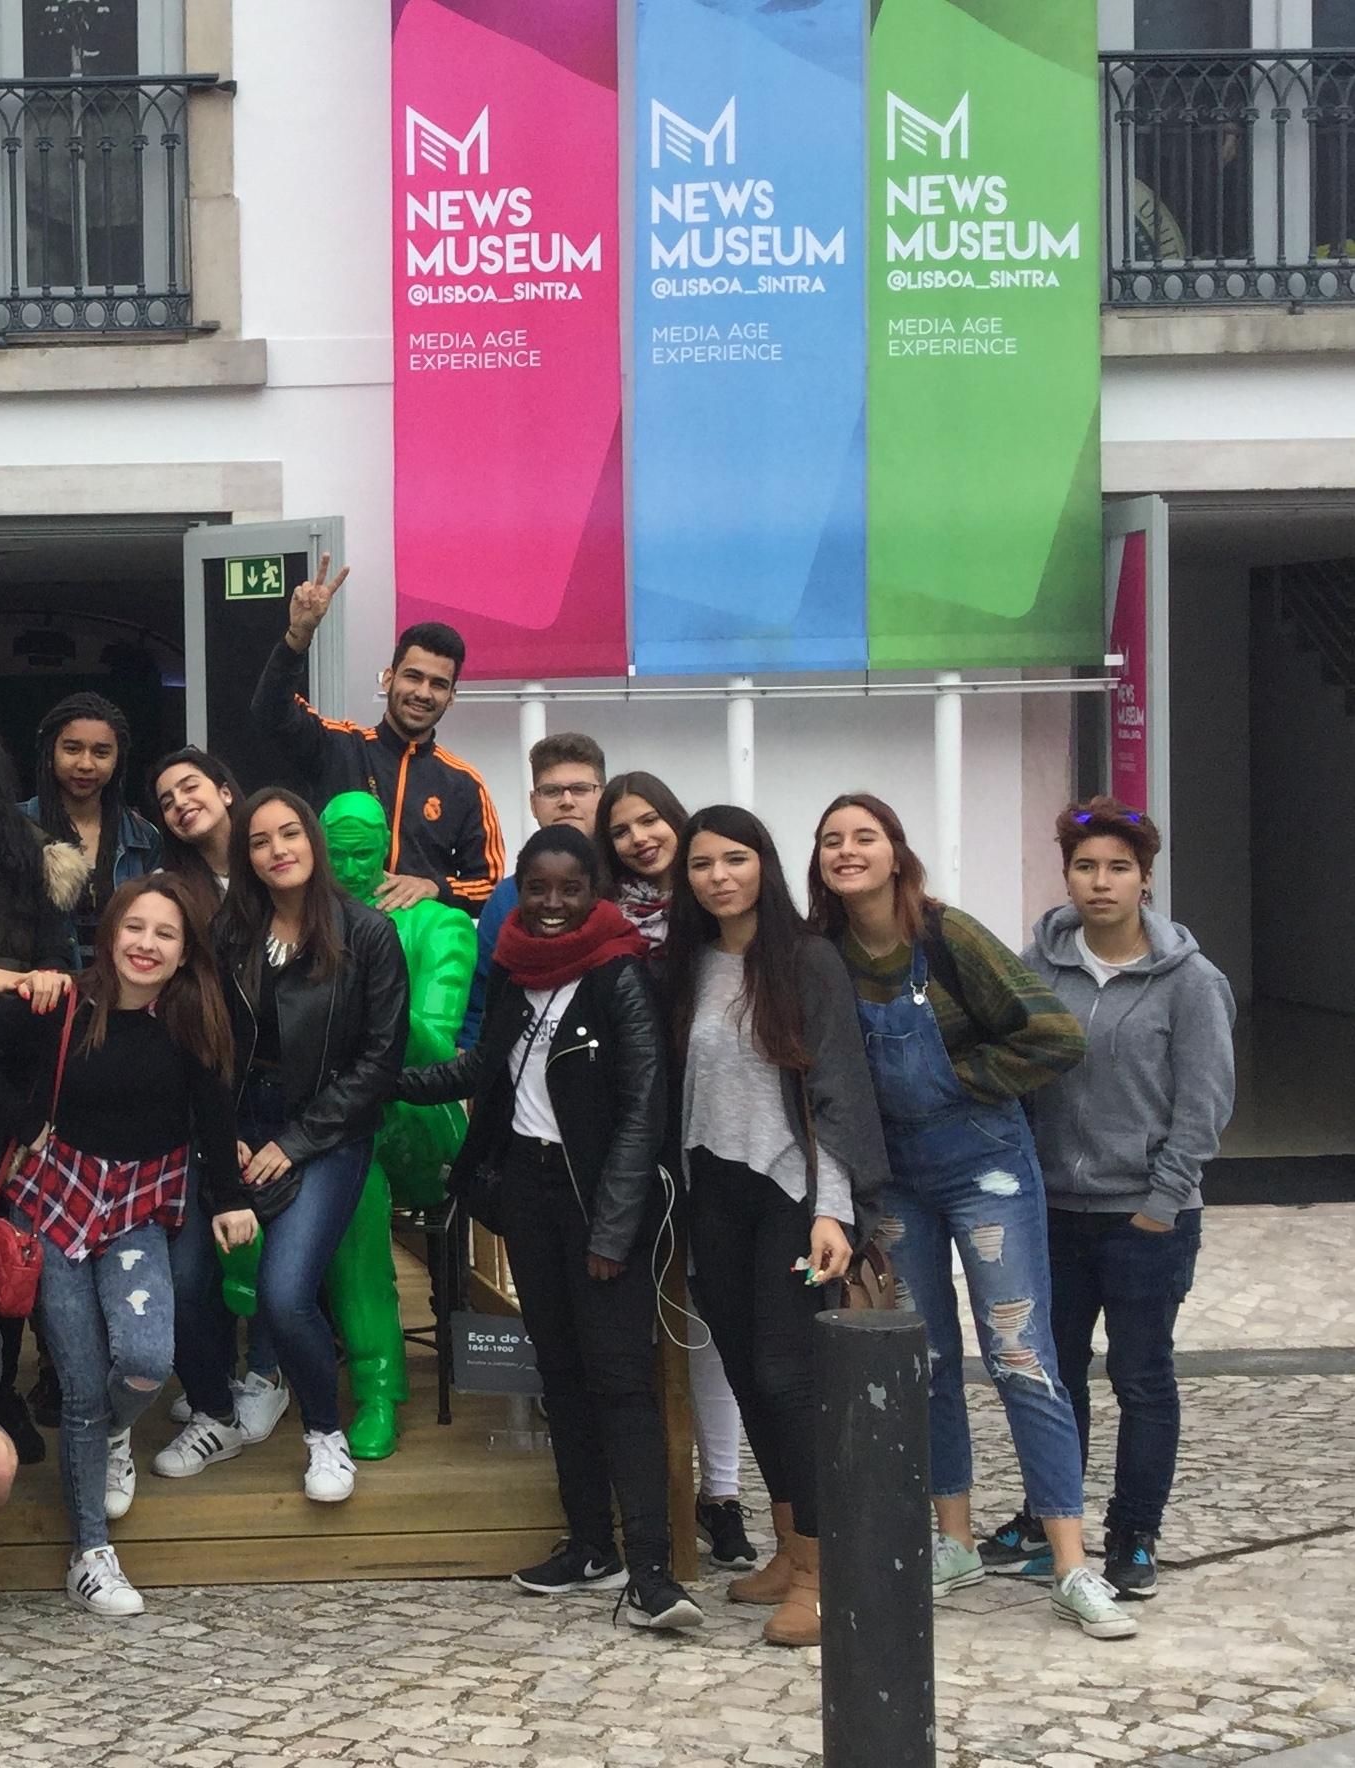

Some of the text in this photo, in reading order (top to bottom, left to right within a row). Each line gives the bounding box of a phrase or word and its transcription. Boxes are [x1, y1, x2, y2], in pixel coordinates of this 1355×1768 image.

[651, 180, 774, 223] NEWS
[886, 175, 1007, 216] NEWS
[406, 188, 532, 231] NEWS
[651, 226, 845, 269] MUSEUM
[886, 221, 1080, 262] MUSEUM
[406, 233, 602, 276] MUSEUM
[651, 276, 826, 299] @LISBOA_SINTRA
[887, 270, 1060, 292] @LISBOA_SINTRA
[407, 283, 583, 305] @LISBOA_SINTRA
[652, 323, 769, 343] MEDIA AGE
[888, 318, 1003, 336] MEDIA AGE
[409, 330, 527, 350] MEDIA AGE
[888, 338, 1017, 357] EXPERIENCE
[409, 351, 542, 371] EXPERIENCE
[652, 343, 782, 364] EXPERIENCE
[468, 1332, 495, 1344] Eça
[500, 1333, 520, 1344] de
